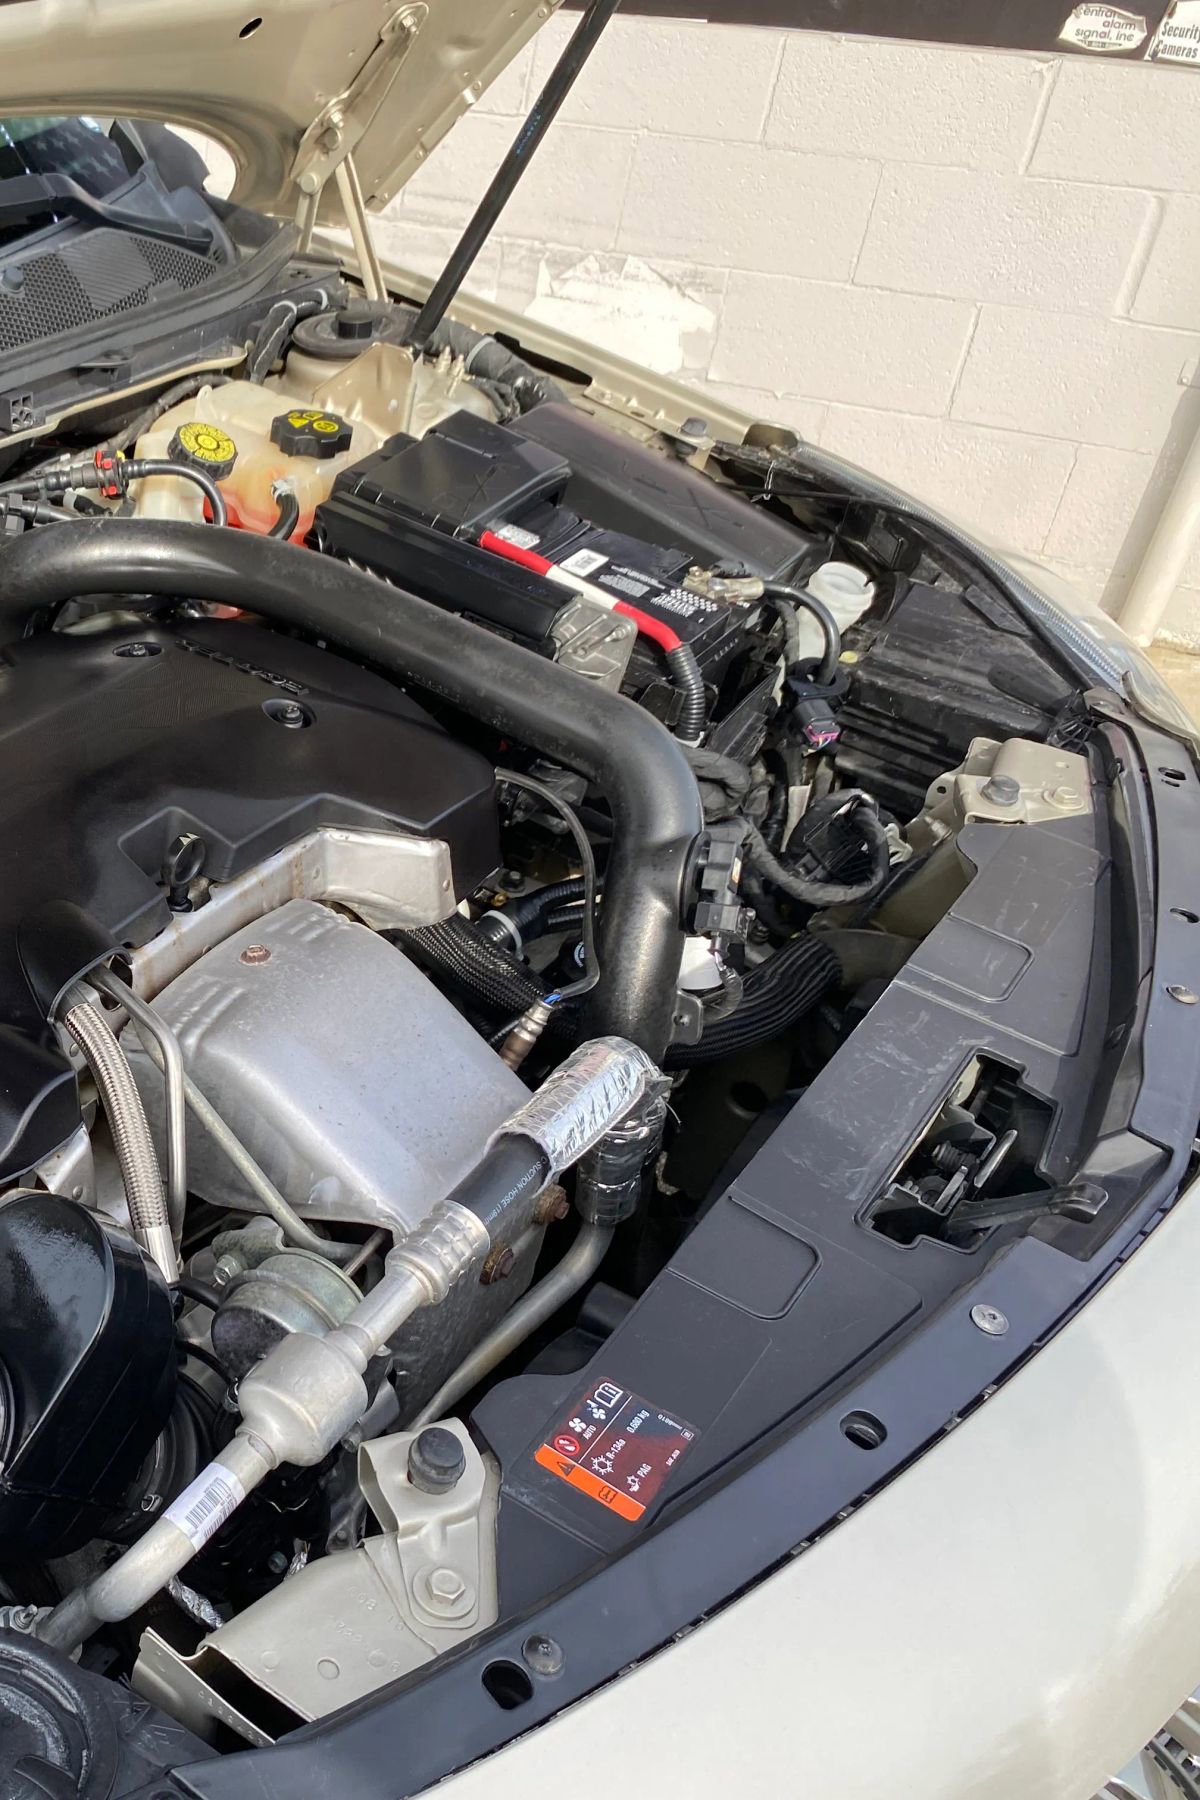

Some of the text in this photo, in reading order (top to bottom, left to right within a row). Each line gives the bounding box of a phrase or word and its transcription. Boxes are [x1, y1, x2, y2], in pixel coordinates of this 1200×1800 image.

[1102, 20, 1136, 31] alarm
[516, 1161, 542, 1191] SUCTION
[501, 1187, 519, 1208] HOSE
[582, 1424, 597, 1440] AUTO
[605, 1438, 627, 1460] R-134a
[636, 1463, 652, 1478] PAG
